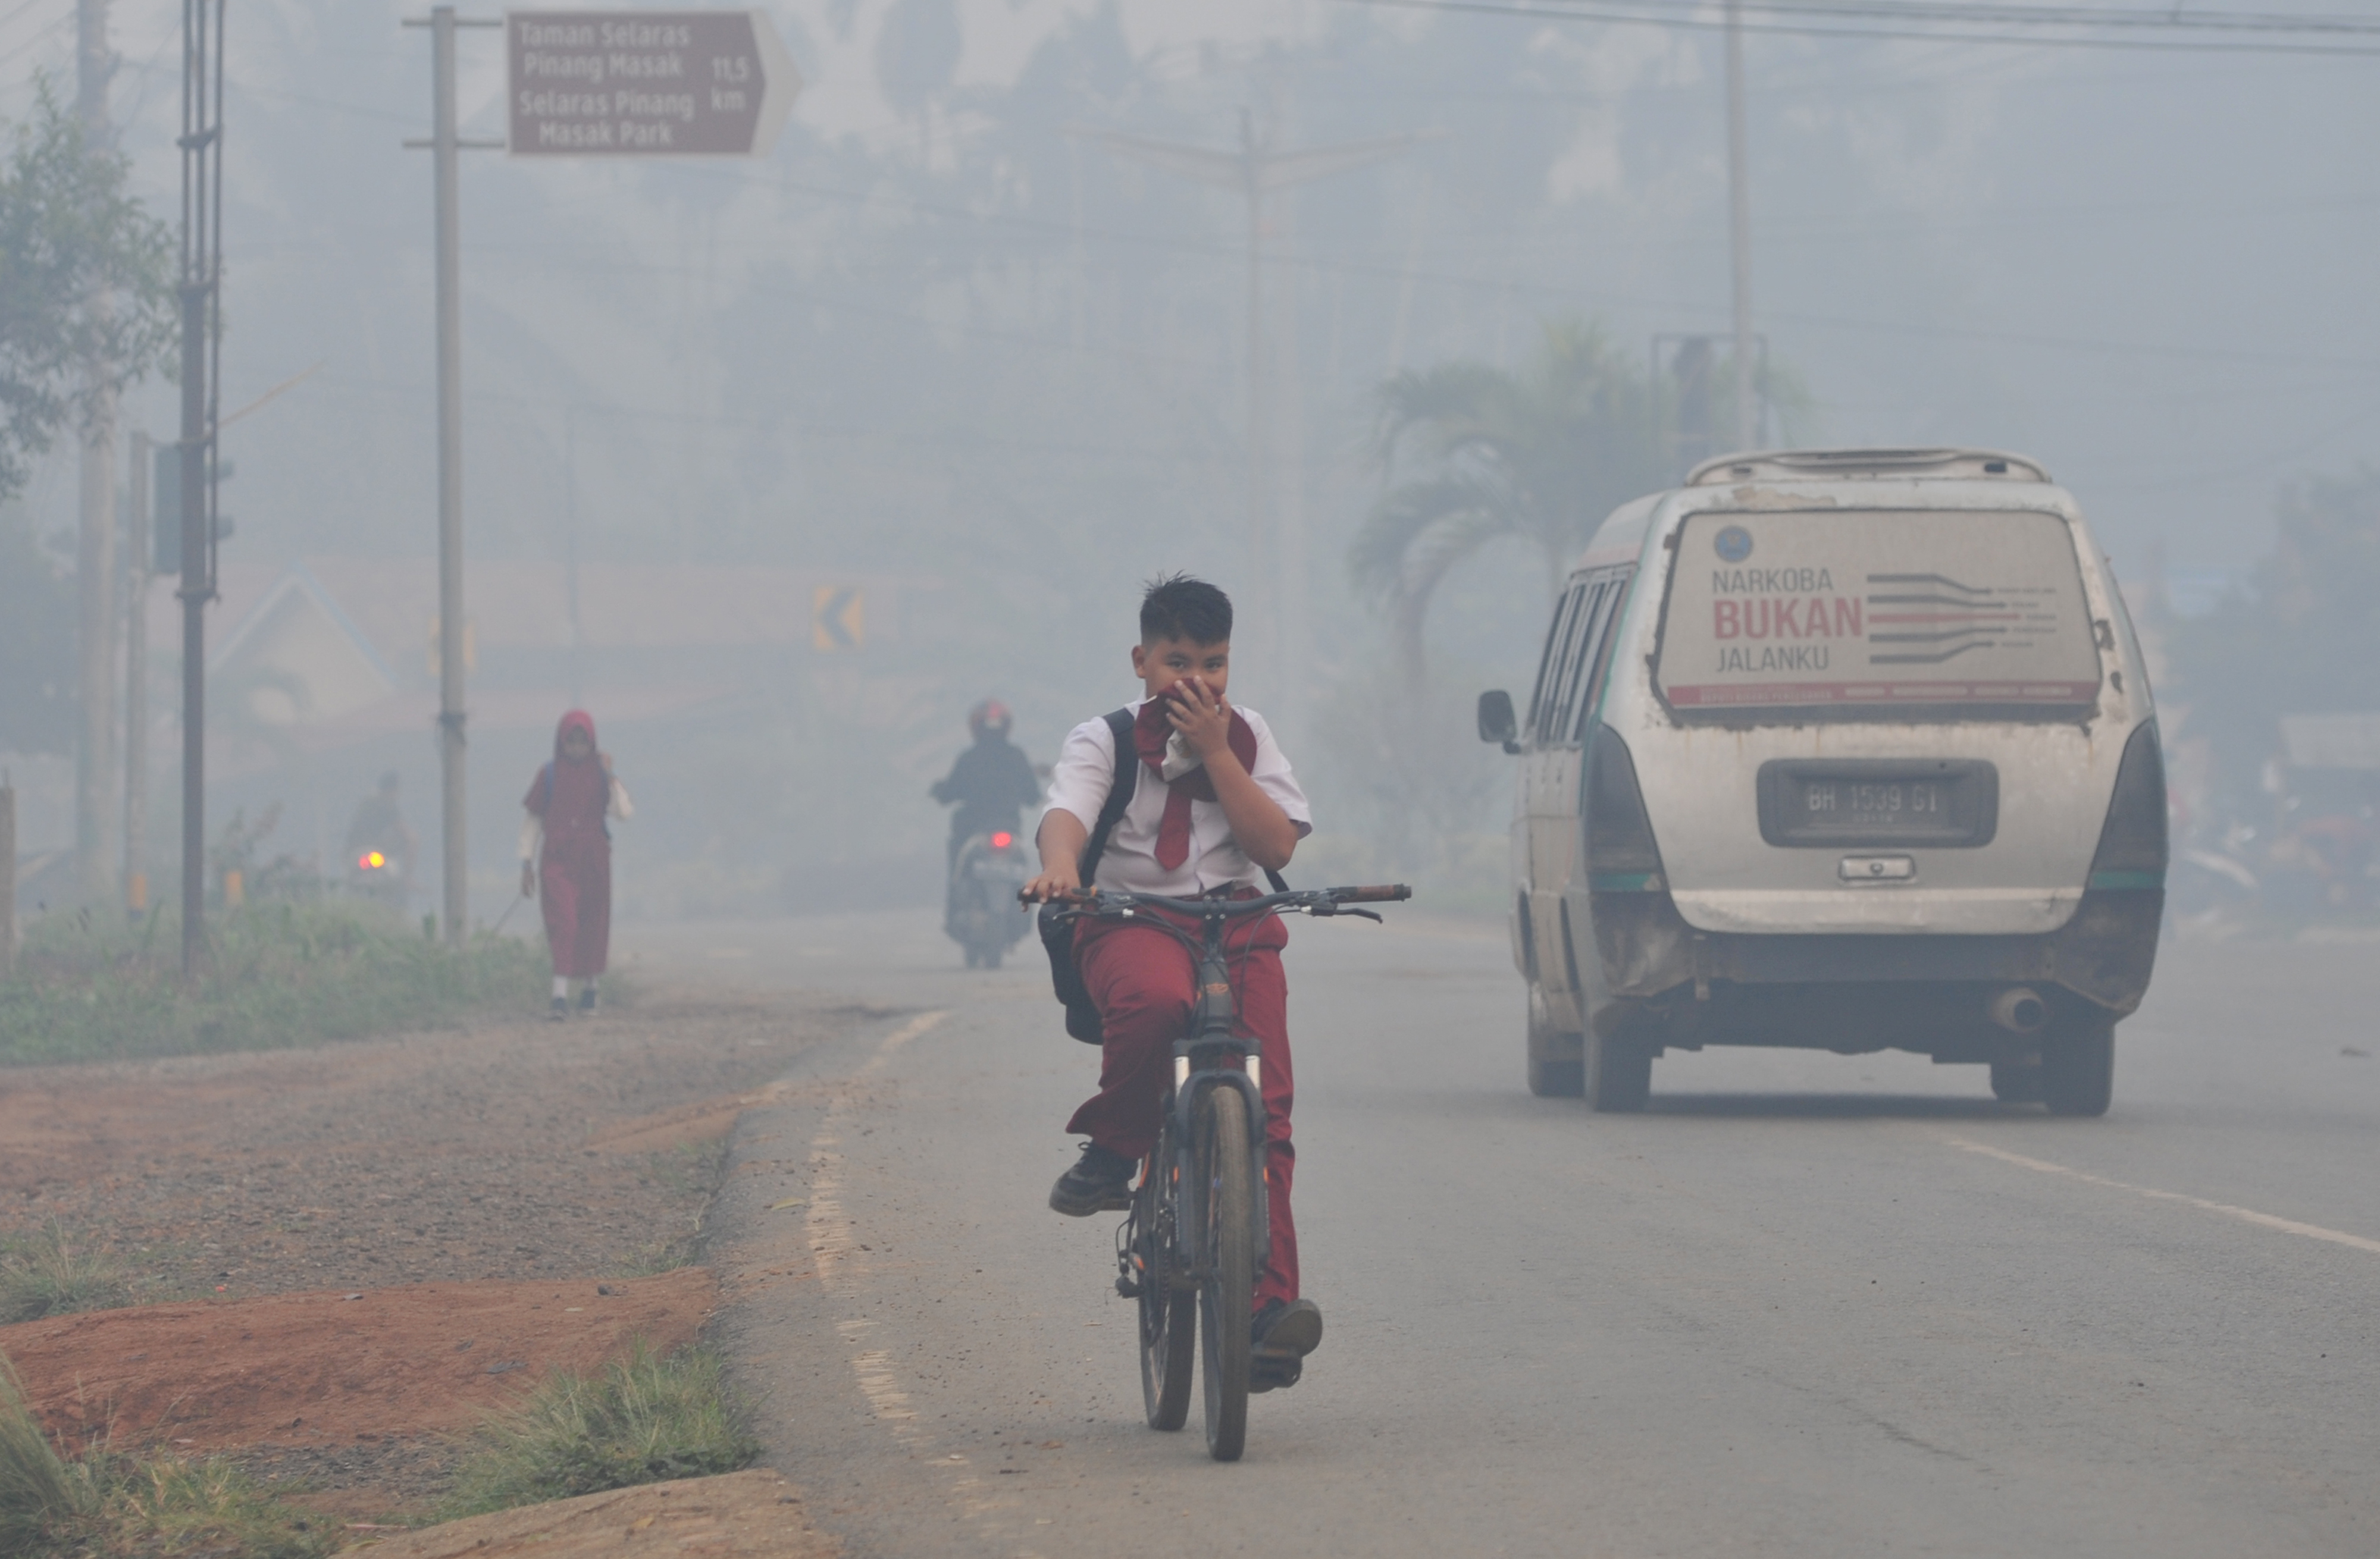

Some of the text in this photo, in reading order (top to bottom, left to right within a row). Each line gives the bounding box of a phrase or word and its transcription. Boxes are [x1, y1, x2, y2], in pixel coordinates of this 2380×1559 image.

[519, 21, 691, 47] Taman Selaras
[524, 51, 683, 84] Pinang Masak
[519, 89, 694, 122] Selaras Pinang
[712, 87, 746, 112] km
[539, 119, 673, 146] Masak Park
[1712, 568, 1834, 593] NARKOBA
[1714, 597, 1863, 639] BUKAN
[1716, 645, 1830, 672] JALANKU
[1808, 784, 1836, 811] BH
